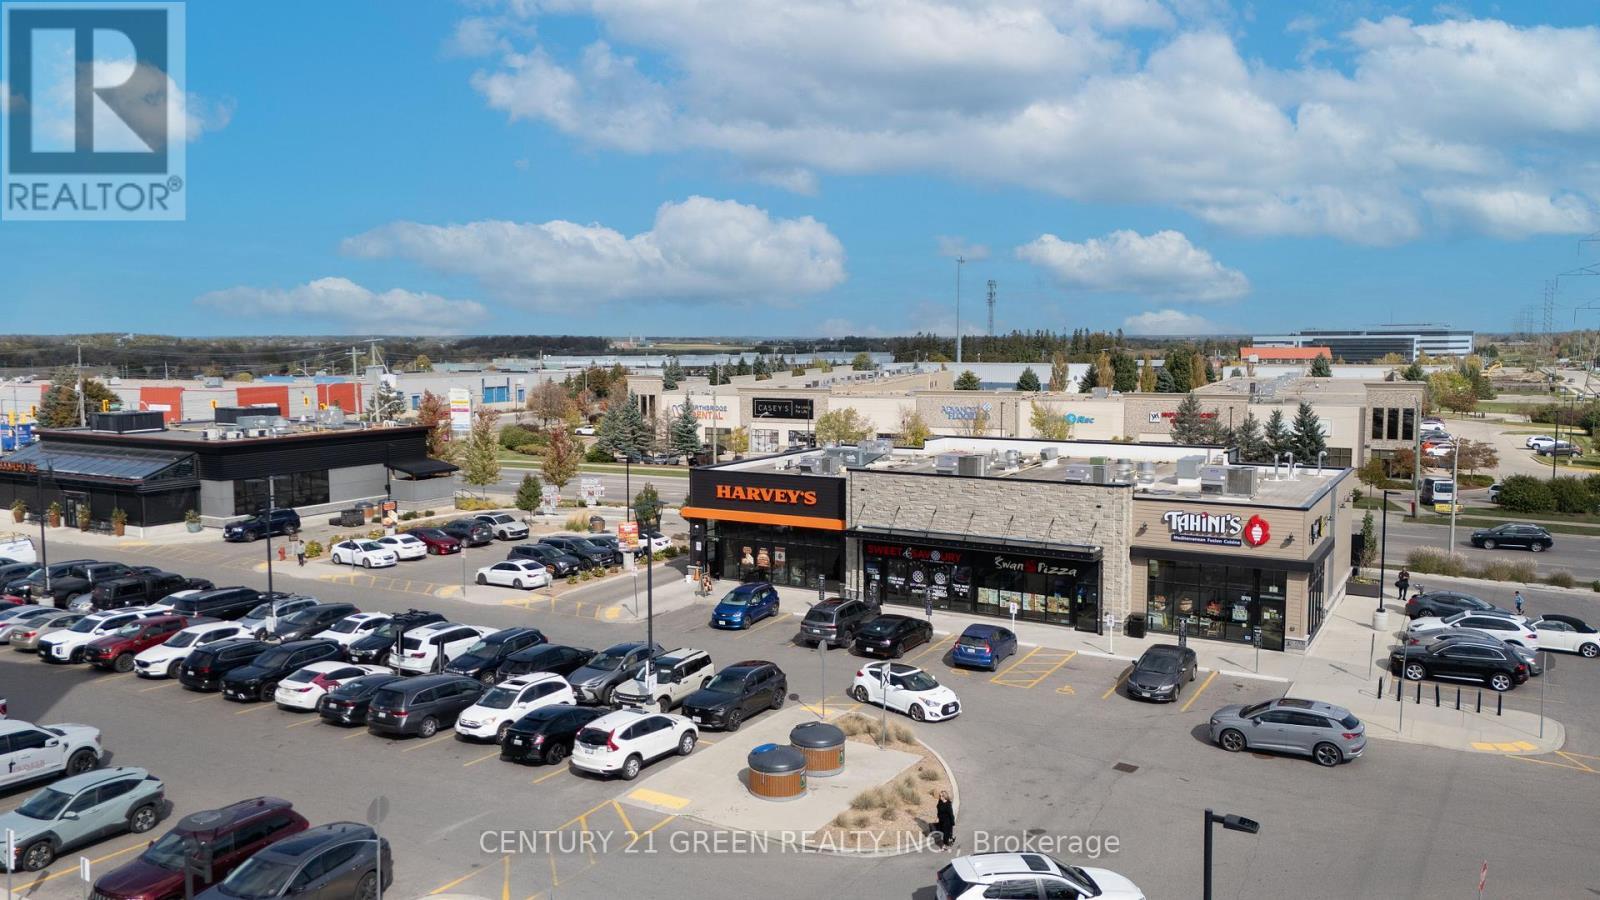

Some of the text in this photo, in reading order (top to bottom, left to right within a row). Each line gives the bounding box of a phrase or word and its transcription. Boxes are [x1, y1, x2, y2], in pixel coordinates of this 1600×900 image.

[758, 404, 790, 412] CASEY'S
[716, 485, 817, 505] HARVEY'S
[866, 544, 903, 557] SWEET
[994, 555, 1078, 577] Swan Pizza
